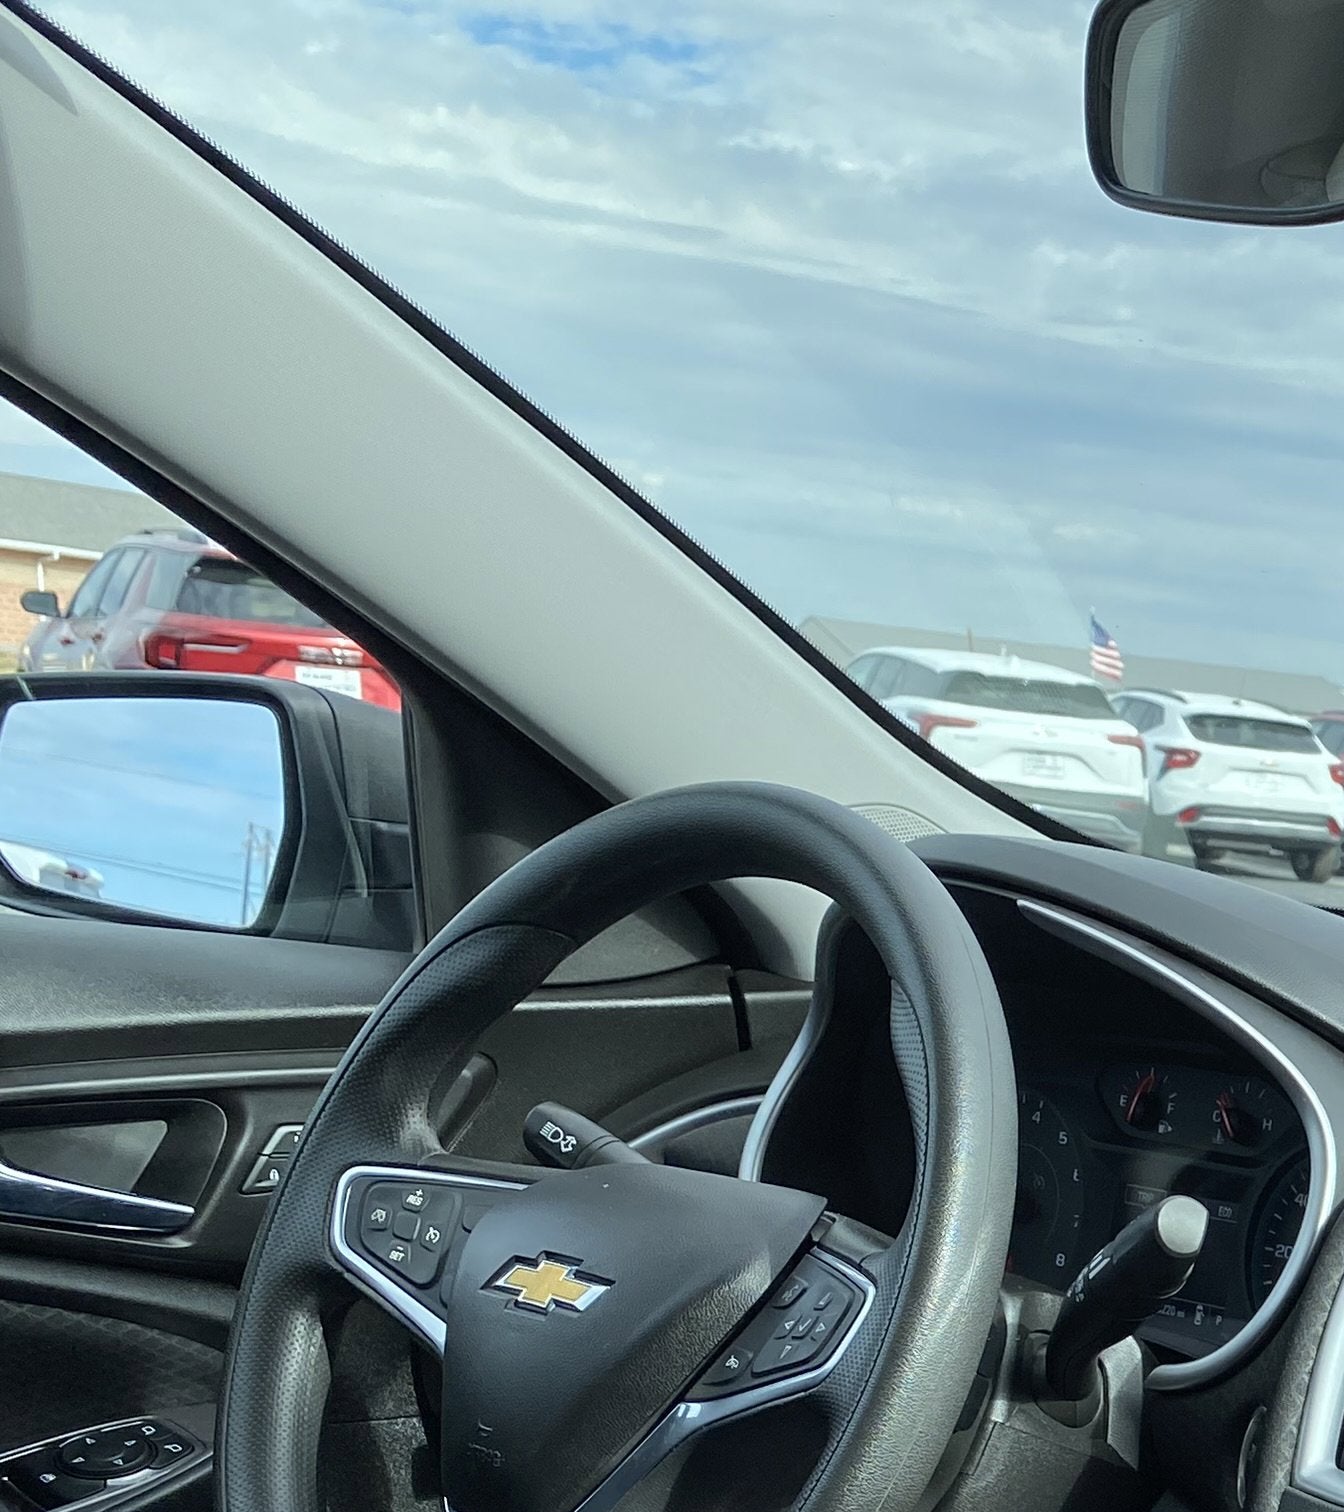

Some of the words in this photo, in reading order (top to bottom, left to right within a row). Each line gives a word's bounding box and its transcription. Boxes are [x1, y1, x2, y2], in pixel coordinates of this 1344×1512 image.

[1119, 1094, 1128, 1107] E
[1167, 1103, 1176, 1114] F
[1032, 1111, 1041, 1124] 4
[1262, 1118, 1273, 1131] H
[1058, 1131, 1067, 1145] 5
[1294, 1193, 1309, 1206] 4
[1055, 1253, 1066, 1267] 8
